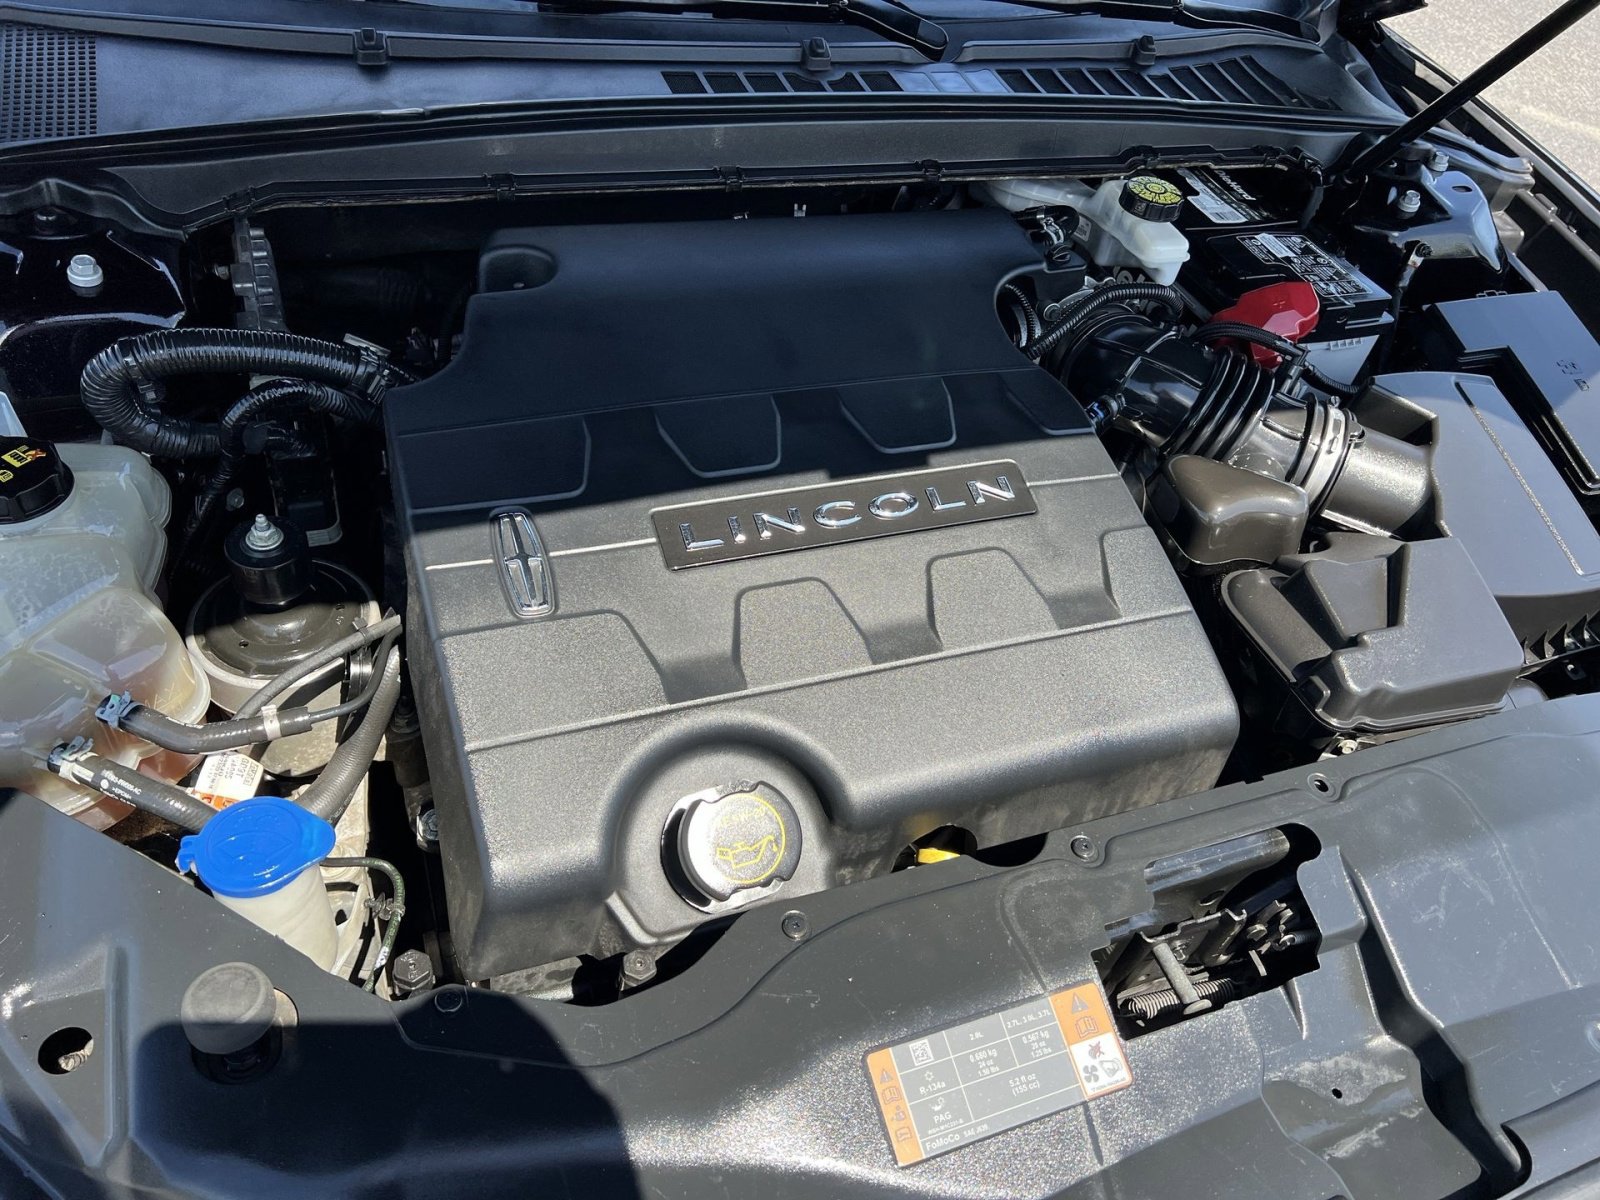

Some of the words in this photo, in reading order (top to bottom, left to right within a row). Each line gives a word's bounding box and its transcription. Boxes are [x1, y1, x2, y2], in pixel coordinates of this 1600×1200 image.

[678, 475, 1015, 551] LINCOLN
[987, 1048, 998, 1057] kg
[919, 1081, 946, 1095] R-134a
[1009, 1078, 1020, 1087] 5.2
[1020, 1075, 1027, 1083] fl
[1012, 1085, 1027, 1097] (155
[1029, 1080, 1040, 1090] cc)
[933, 1111, 952, 1124] PAG
[925, 1134, 960, 1151] FoMoCo
